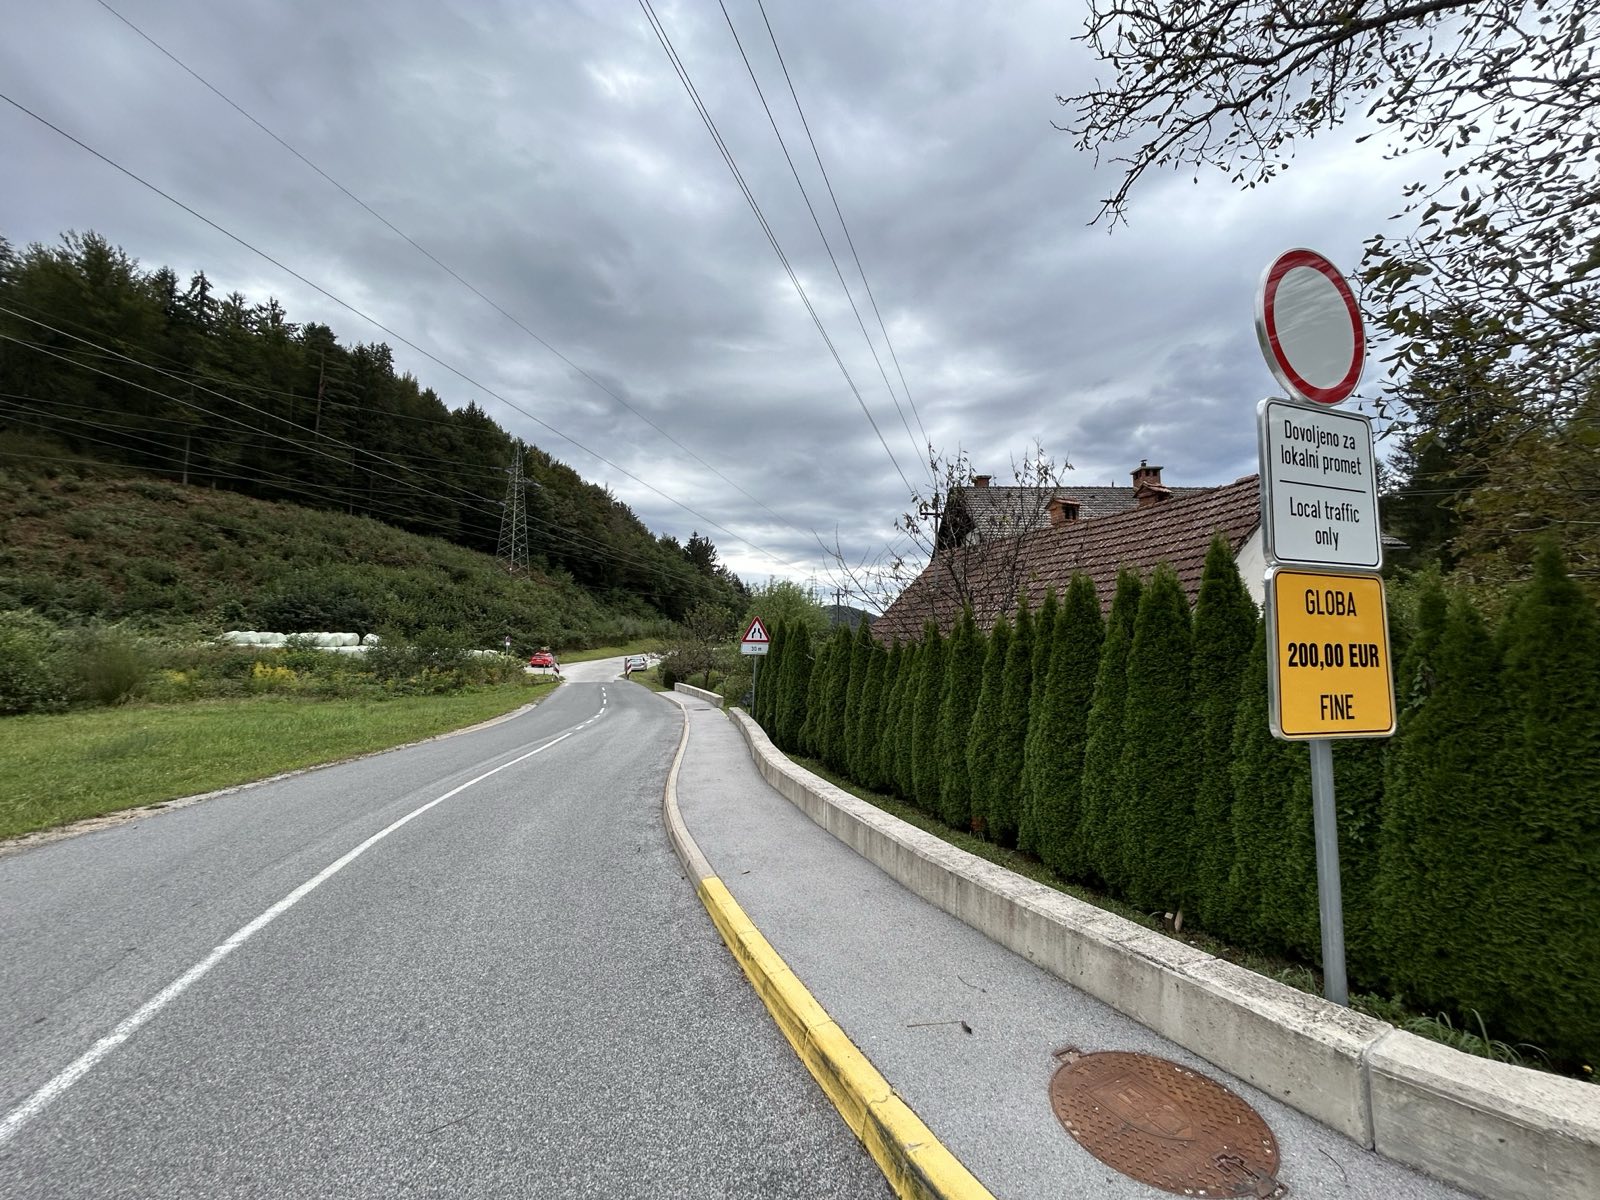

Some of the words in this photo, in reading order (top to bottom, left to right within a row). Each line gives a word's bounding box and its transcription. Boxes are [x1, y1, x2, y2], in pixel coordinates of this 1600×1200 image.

[1284, 420, 1339, 448] Dovoljeno
[1343, 434, 1356, 450] za
[1281, 445, 1319, 469] lokalni
[1323, 455, 1362, 475] promet
[1290, 496, 1321, 519] Local
[1324, 501, 1360, 523] traffic
[1315, 527, 1339, 551] only
[1305, 589, 1357, 617] GLOBA
[1288, 642, 1344, 671] 200,00
[1349, 643, 1379, 668] EUR
[1320, 694, 1355, 721] FINE
